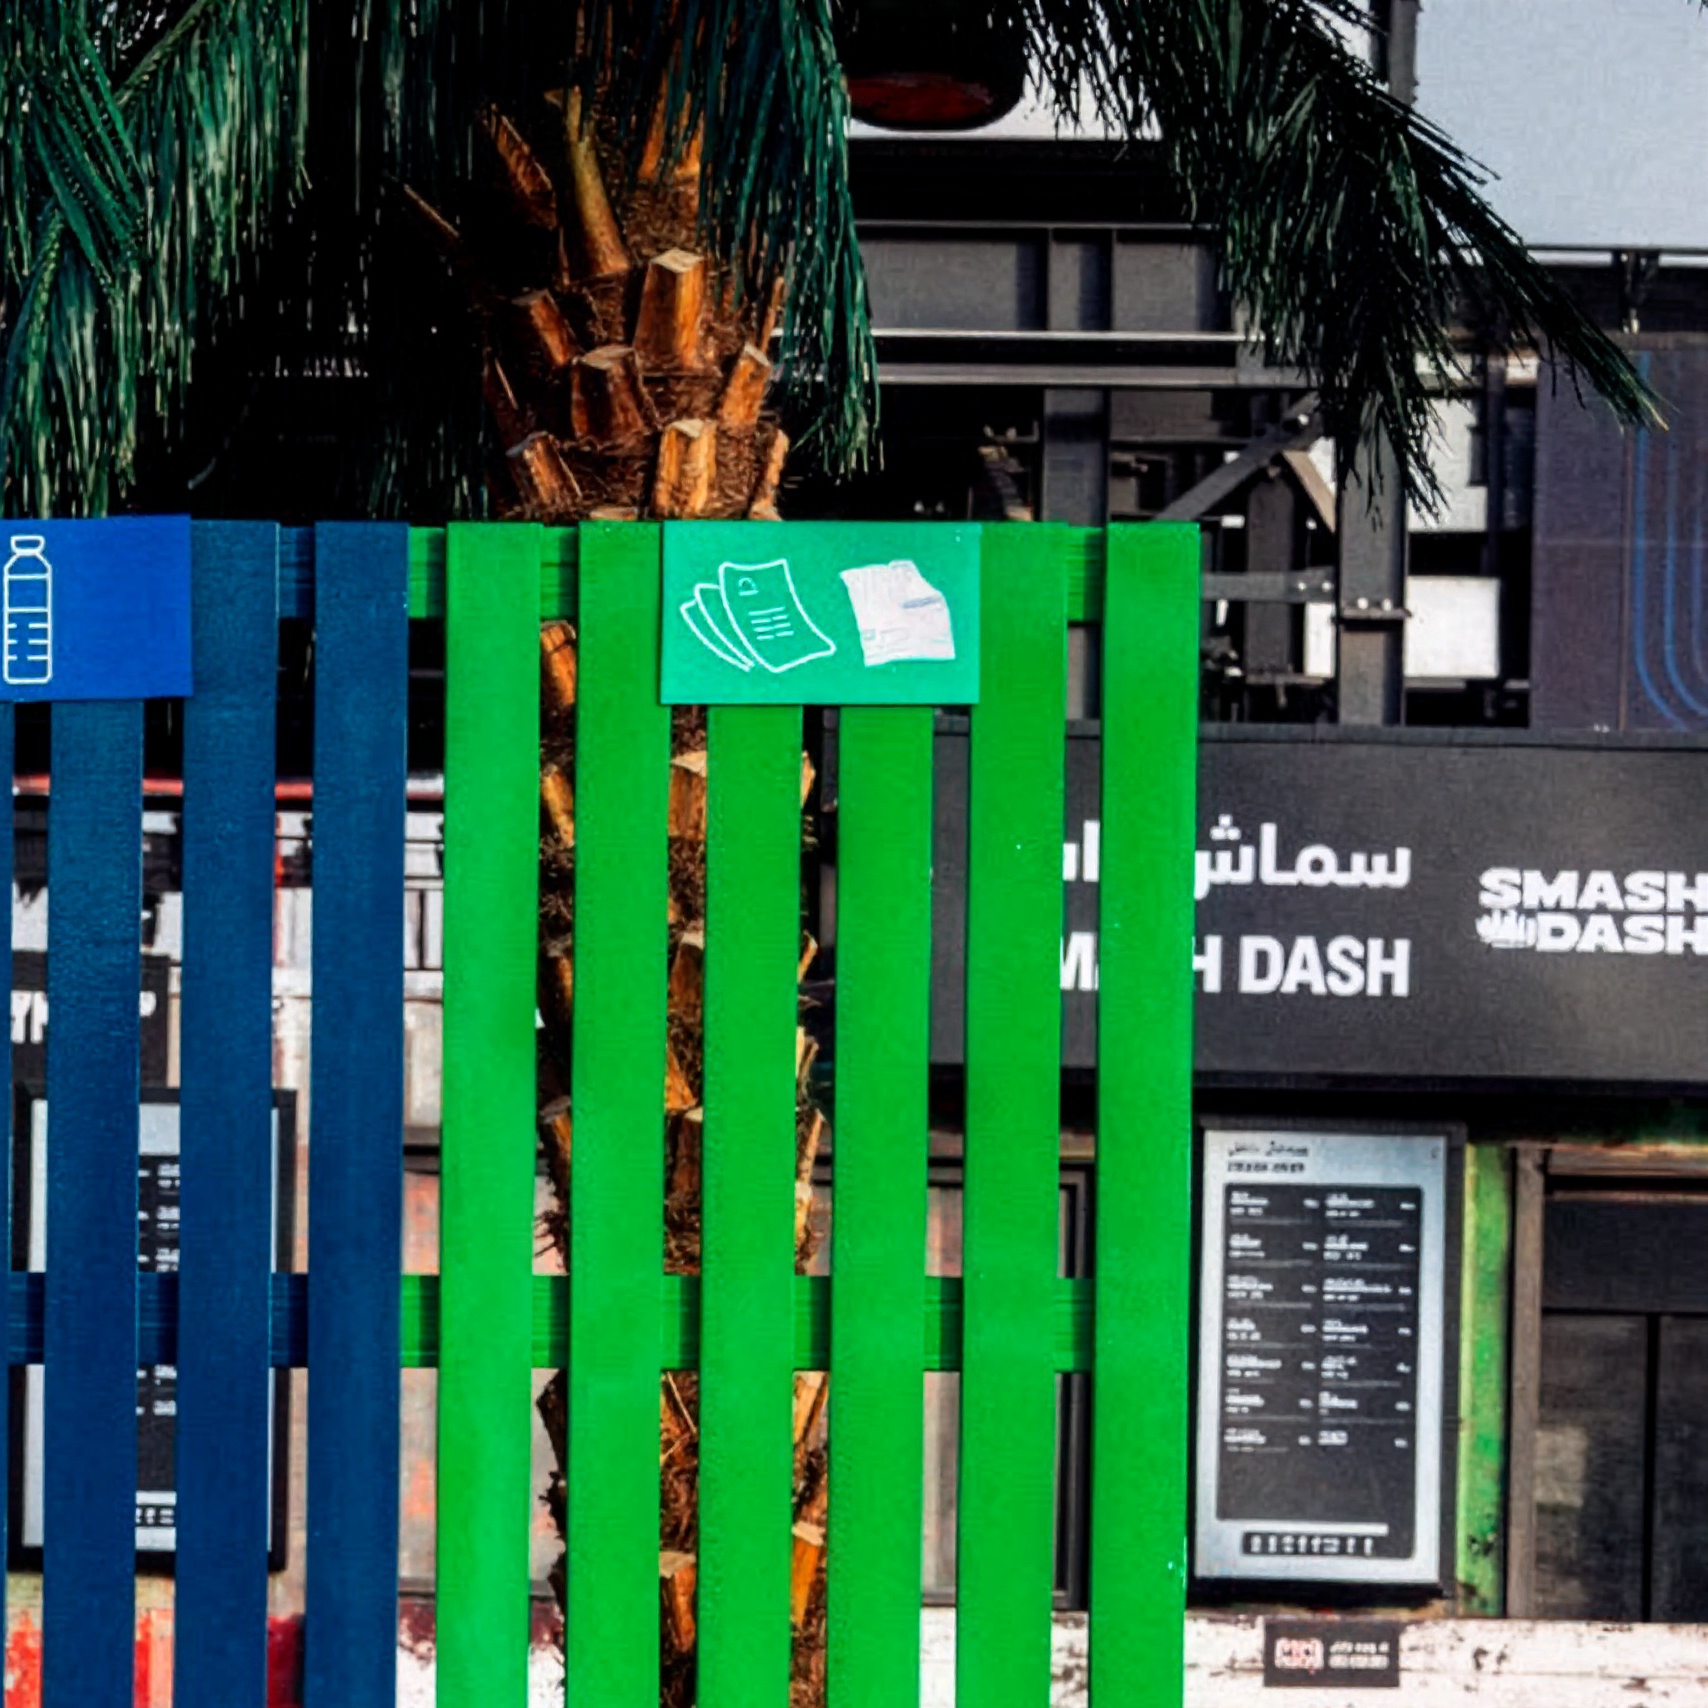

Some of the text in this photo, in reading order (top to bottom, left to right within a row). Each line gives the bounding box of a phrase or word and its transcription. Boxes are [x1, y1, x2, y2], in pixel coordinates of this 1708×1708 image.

[1478, 867, 1708, 912] SMASH
[1535, 912, 1708, 955] DASH
[1238, 934, 1412, 998] DASH
